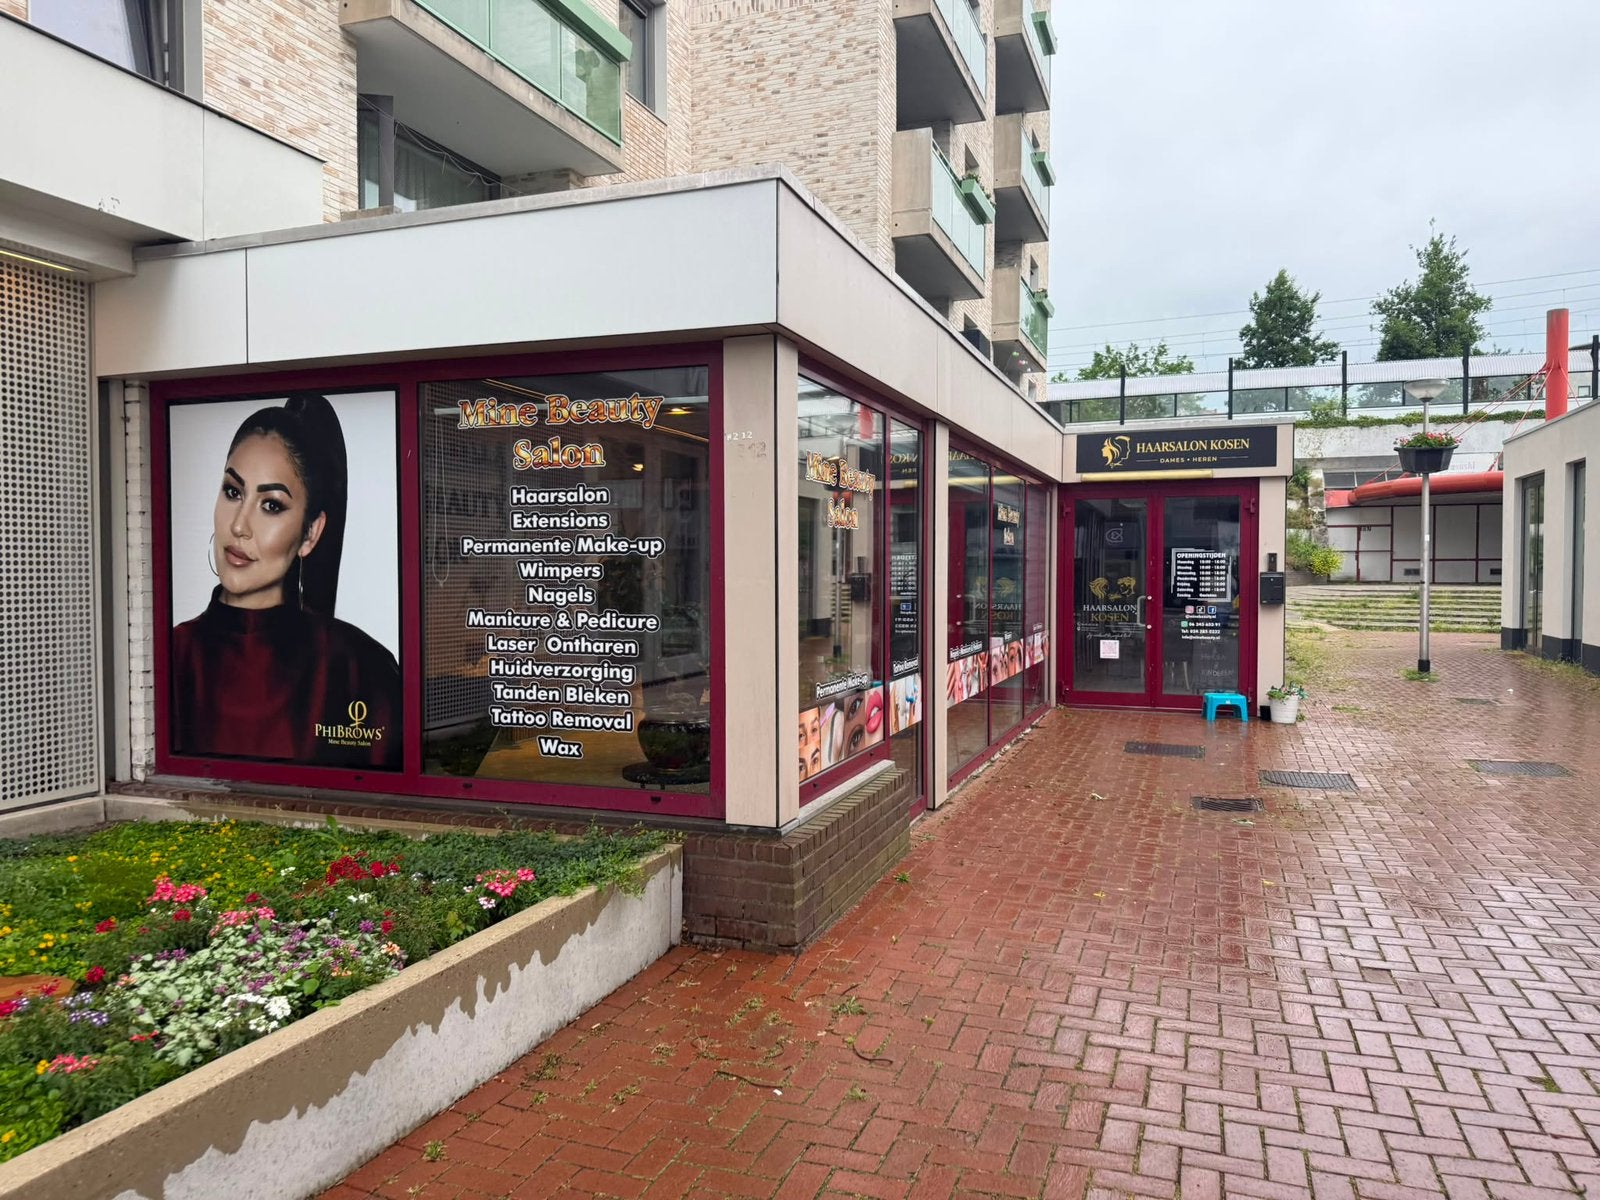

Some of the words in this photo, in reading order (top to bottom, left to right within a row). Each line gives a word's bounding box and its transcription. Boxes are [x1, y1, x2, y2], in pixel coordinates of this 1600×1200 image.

[458, 397, 539, 429] Mine
[545, 393, 664, 429] Beauty
[513, 436, 606, 470] Salon
[1136, 440, 1208, 453] HAARSALON
[1210, 438, 1250, 450] KOSEN
[511, 485, 609, 505] Haarsalon
[512, 511, 609, 530] Extensions
[462, 537, 573, 555] Permanente
[576, 536, 664, 557] Make-up
[519, 561, 602, 580] Wimpers
[528, 586, 594, 605] Nagels
[468, 610, 551, 628] Manicure
[556, 610, 571, 628] &
[576, 611, 659, 631] Pedicure
[1091, 613, 1129, 621] KOSEN
[487, 635, 538, 653] Laser
[546, 636, 637, 655] Ontharen
[490, 659, 634, 683] Huidverzorging
[494, 684, 561, 702] Tanden
[565, 686, 630, 705] Bleken
[816, 678, 847, 699] Permanente
[491, 708, 547, 726] Tattoo
[552, 709, 632, 730] Removal
[539, 738, 582, 756] Wax
